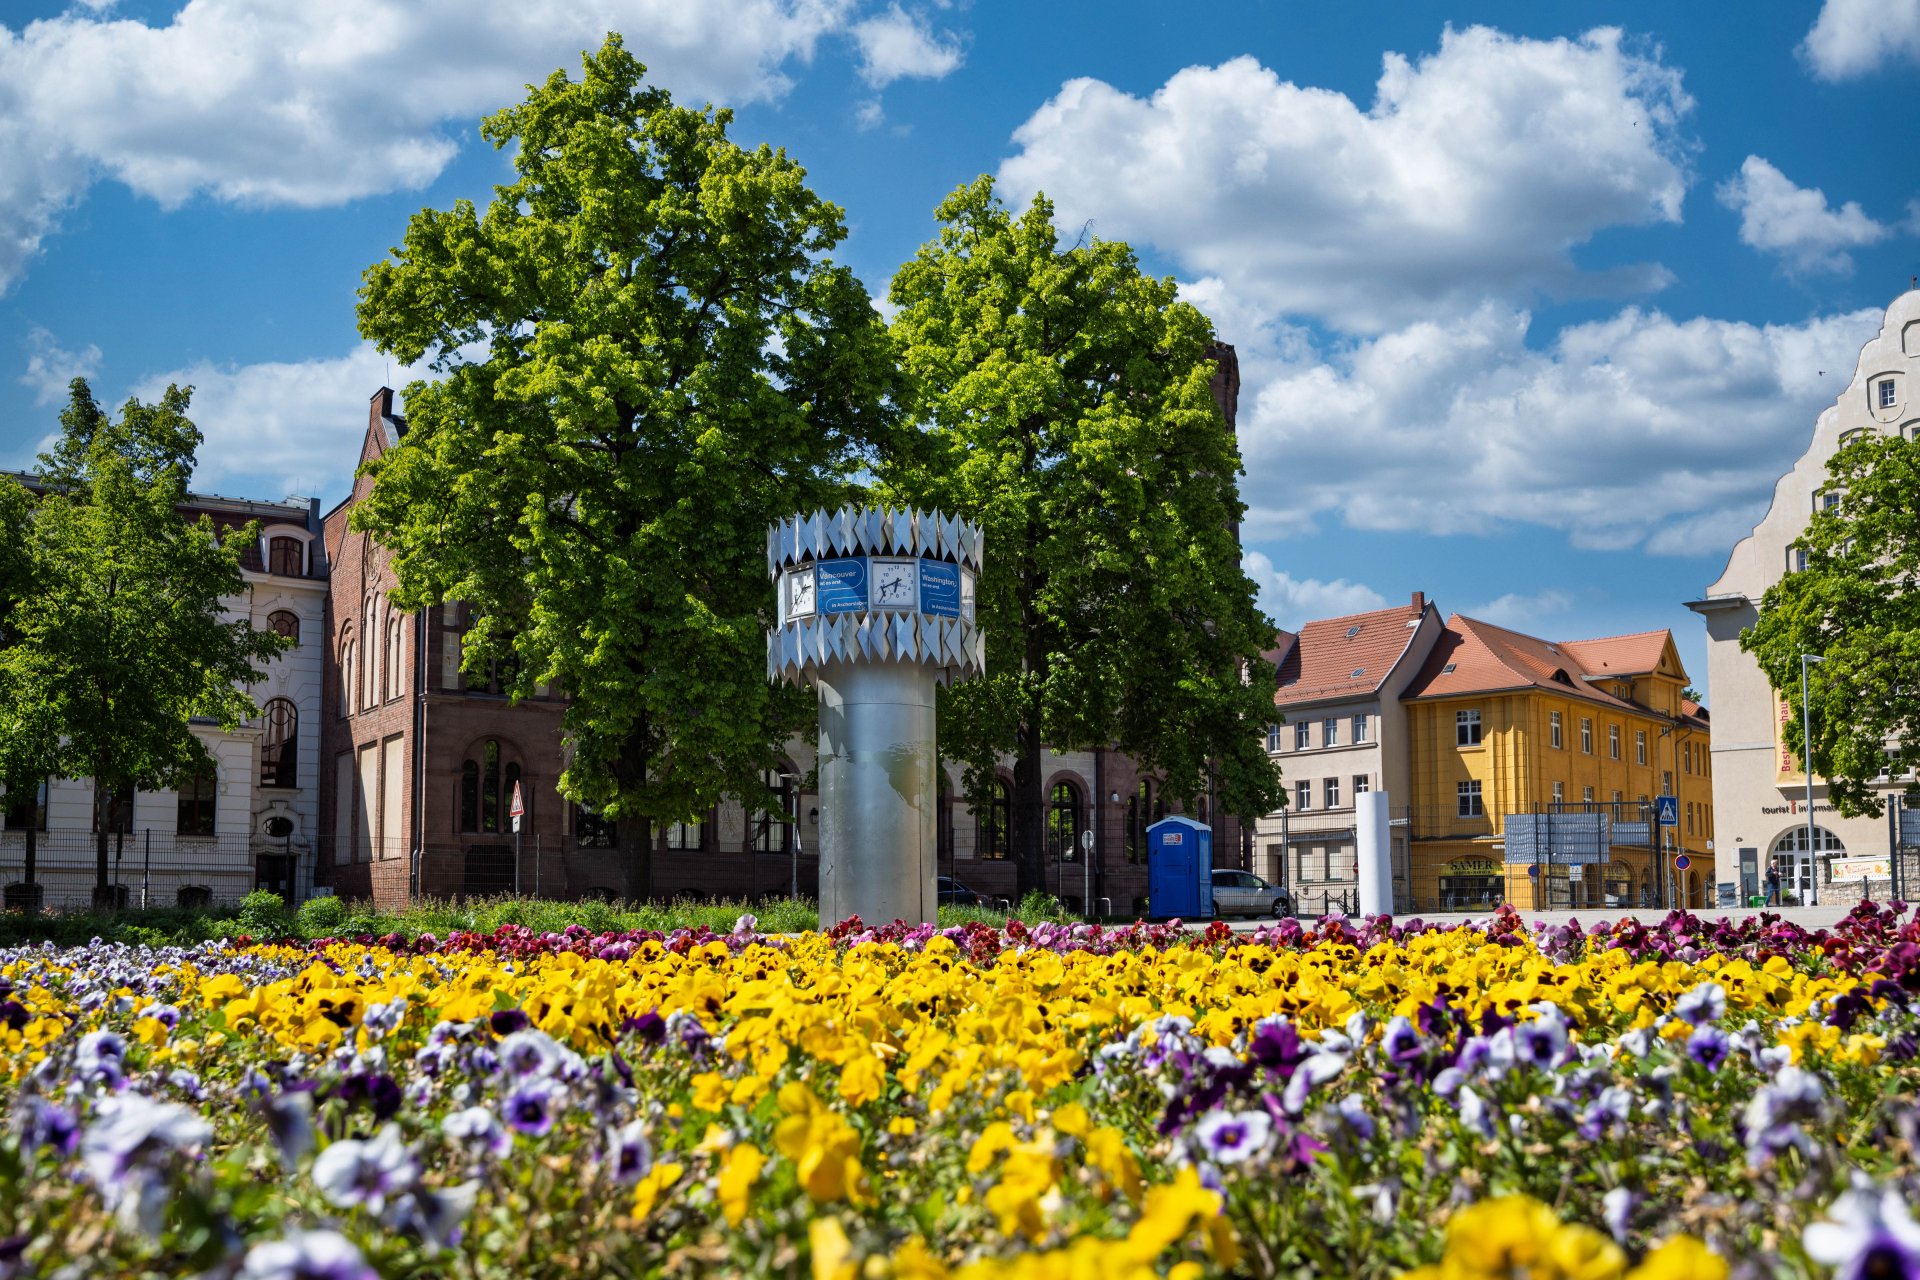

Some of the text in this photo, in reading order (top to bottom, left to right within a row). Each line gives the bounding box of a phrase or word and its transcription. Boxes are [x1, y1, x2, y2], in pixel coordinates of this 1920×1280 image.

[820, 571, 856, 579] Vancouver
[922, 574, 955, 586] Washington
[1762, 806, 1789, 814] tourist
